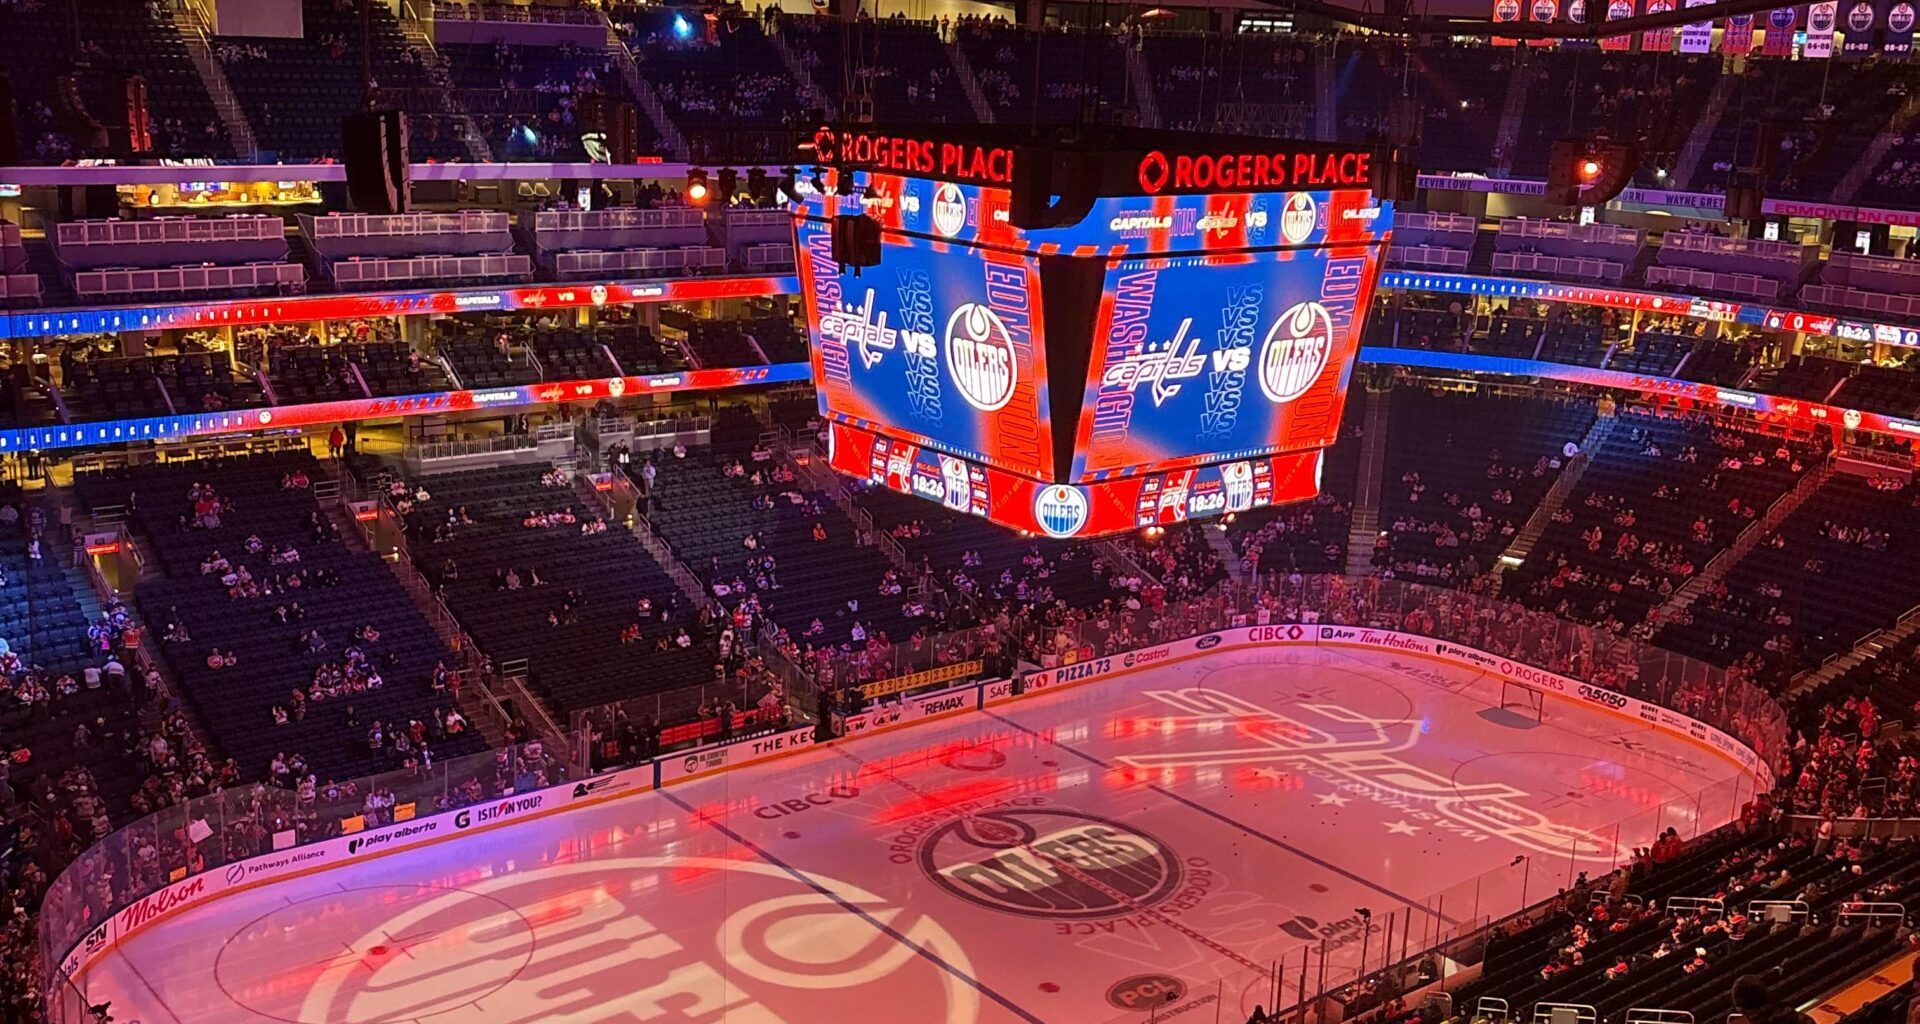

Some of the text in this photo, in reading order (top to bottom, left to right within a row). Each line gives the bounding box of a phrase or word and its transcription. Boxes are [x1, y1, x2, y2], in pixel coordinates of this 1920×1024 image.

[841, 132, 934, 173] ROGERS
[1175, 153, 1371, 187] ROGERS PLACE
[1418, 179, 1472, 190] KEVIN LOWE
[1492, 182, 1522, 193] GLENN
[900, 196, 919, 211] VS
[1665, 195, 1697, 207] WAYNE
[1245, 211, 1267, 227] VS
[1342, 207, 1380, 219] OILERS
[1775, 203, 1882, 221] EDMONTON
[1110, 216, 1172, 231] CAPITALS
[558, 293, 574, 301] VS
[632, 287, 662, 296] OILERS
[1384, 276, 1640, 304] EDMONTON OILERS HOCKEY CLUB
[455, 296, 499, 306] CAPITALS
[28, 307, 283, 331] THIS IS OIL COUNTRY
[1794, 316, 1804, 330] 0
[1837, 325, 1871, 341] 18:26
[1906, 331, 1918, 346] 0
[901, 330, 937, 358] VS
[1213, 347, 1250, 371] VS
[1268, 337, 1324, 399] OILERS
[953, 338, 1009, 403] OILERS
[576, 386, 592, 394] VS
[650, 378, 680, 387] OILERS
[472, 392, 517, 402] CAPITALS
[1716, 391, 1756, 404] CAPITALS
[1810, 408, 1827, 418] VS
[0, 417, 243, 446] OILERS HOCKEY CLUB
[912, 473, 945, 499] 18:26
[1189, 492, 1225, 513] 18:26
[1043, 503, 1080, 524] OILERS
[1200, 636, 1218, 648] Ford
[1248, 626, 1285, 642] CIBC
[1360, 630, 1429, 653] Tim Hortons
[1135, 647, 1169, 664] Castrol
[1447, 647, 1497, 667] play alberta
[1056, 659, 1111, 684] PIZZA 73
[1515, 667, 1565, 691] ROGERS
[989, 678, 1035, 699] SAFEAY
[925, 696, 965, 715] REMAX
[1591, 689, 1627, 708] 5050
[753, 738, 783, 755] THE
[517, 796, 543, 812] YOU?
[753, 790, 833, 821] CIBC
[455, 810, 471, 828] G
[366, 821, 437, 848] play alberta
[249, 849, 325, 874] Pathways Alliance
[122, 878, 204, 931] Molson
[86, 924, 107, 952] SN
[1119, 979, 1177, 1007] PCL
